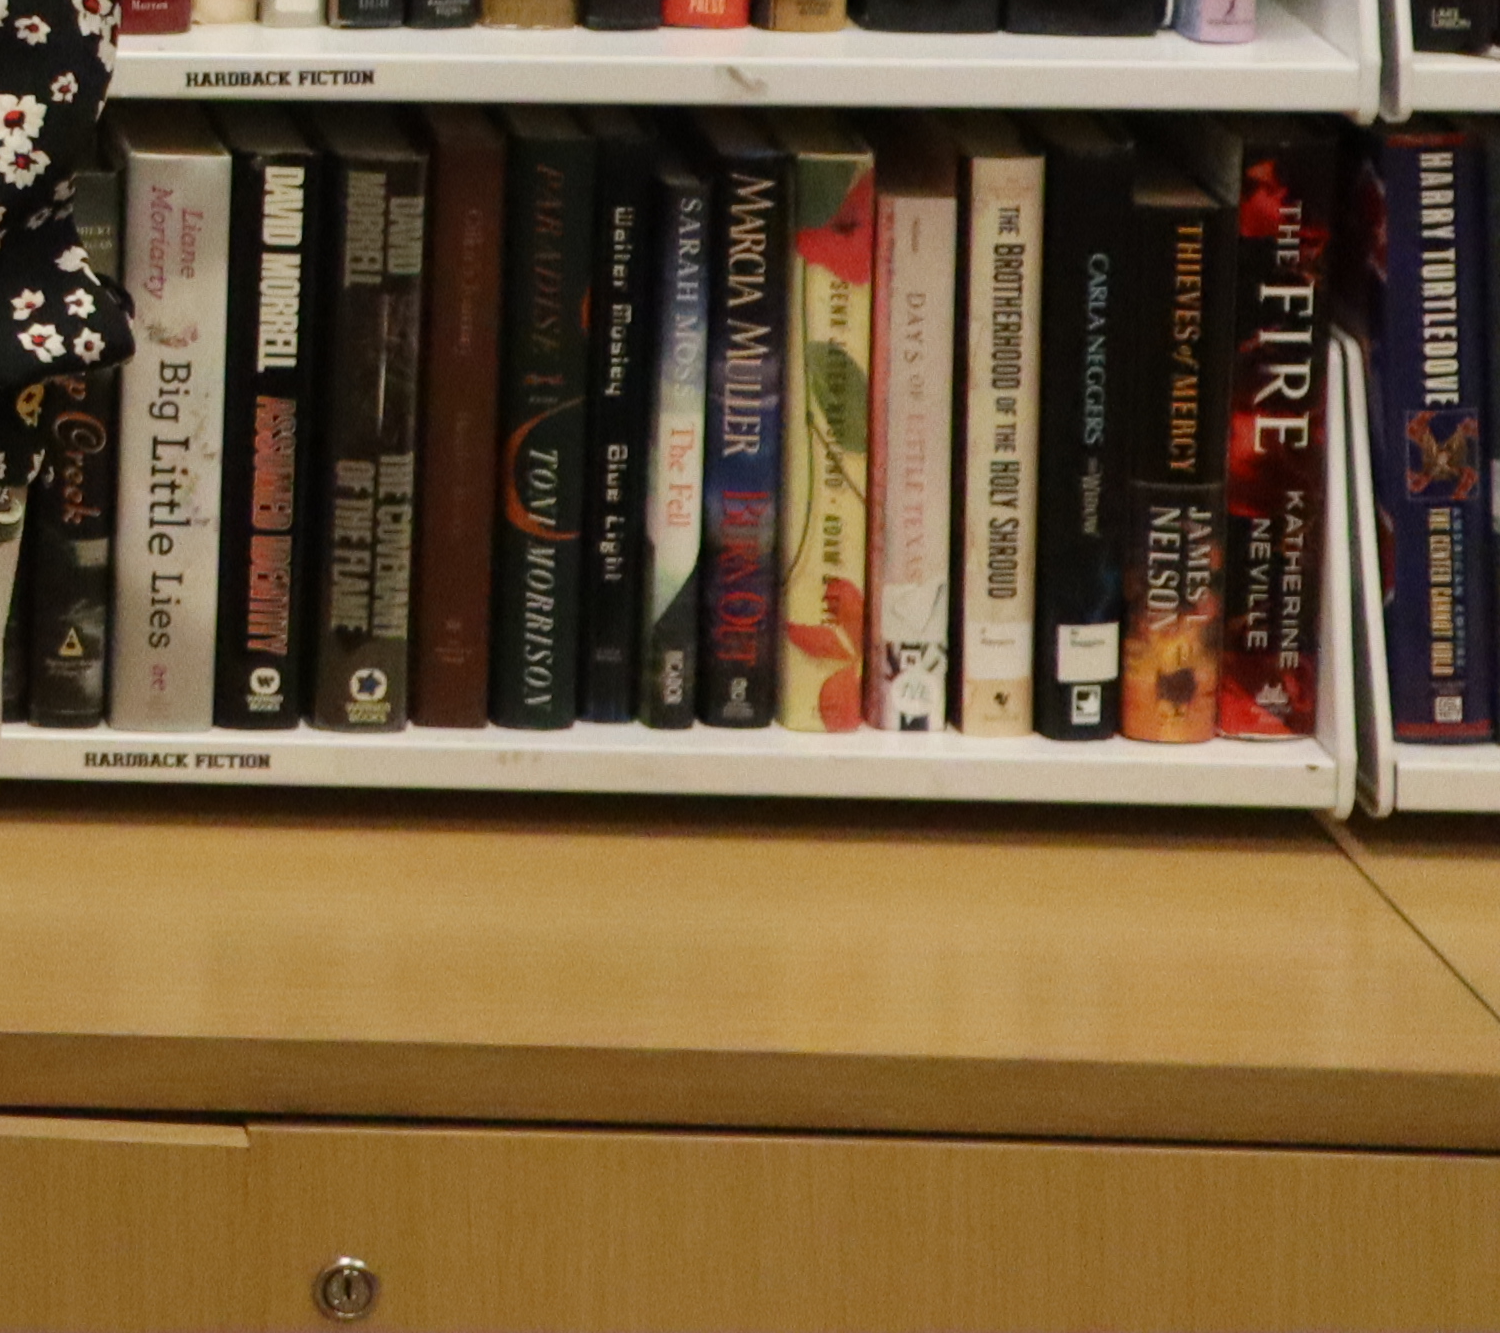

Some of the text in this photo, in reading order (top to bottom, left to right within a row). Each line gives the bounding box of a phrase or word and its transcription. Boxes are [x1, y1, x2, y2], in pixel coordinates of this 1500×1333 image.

[186, 70, 375, 88] HARDBACK FICTION
[1252, 280, 1314, 455] FIRE
[146, 358, 192, 651] Big Little Lies
[84, 752, 271, 769] HARDBACK FICTION
